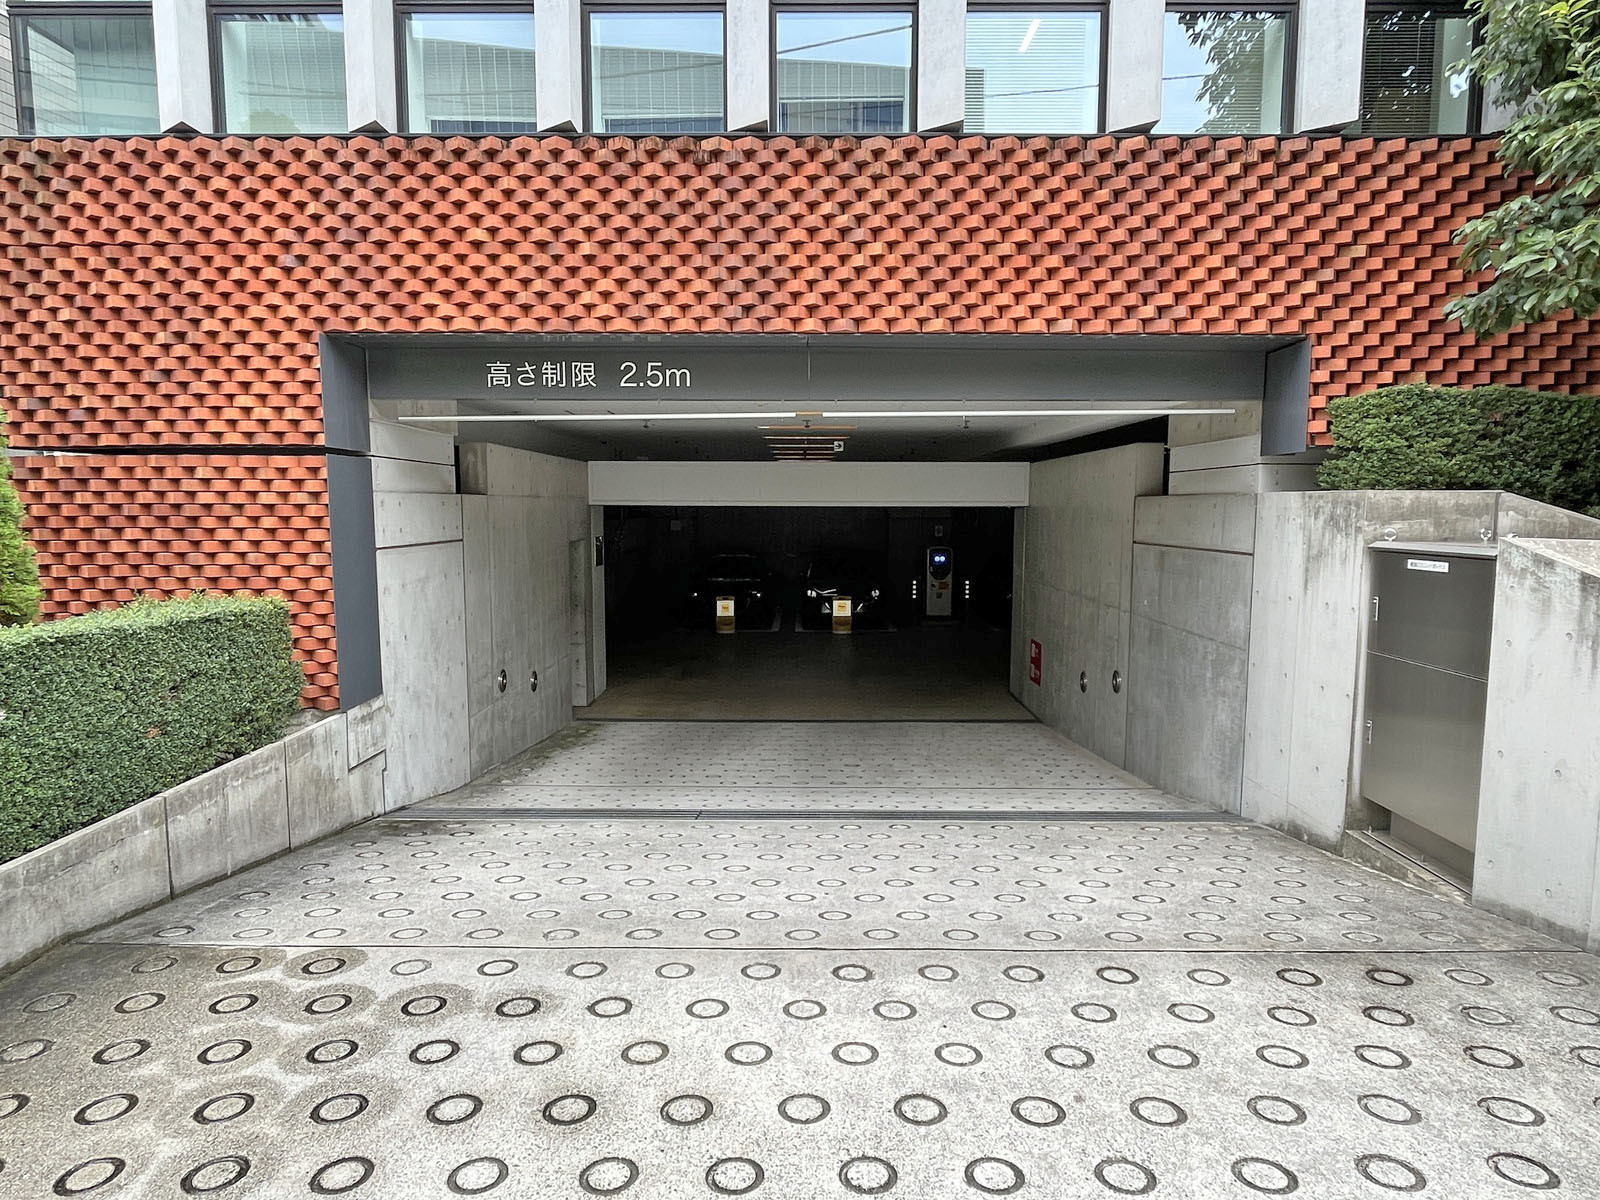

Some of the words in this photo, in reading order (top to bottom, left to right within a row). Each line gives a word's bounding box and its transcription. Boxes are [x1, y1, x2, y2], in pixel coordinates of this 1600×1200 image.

[486, 361, 597, 388] 高さ制限
[619, 361, 692, 388] 2.5m
